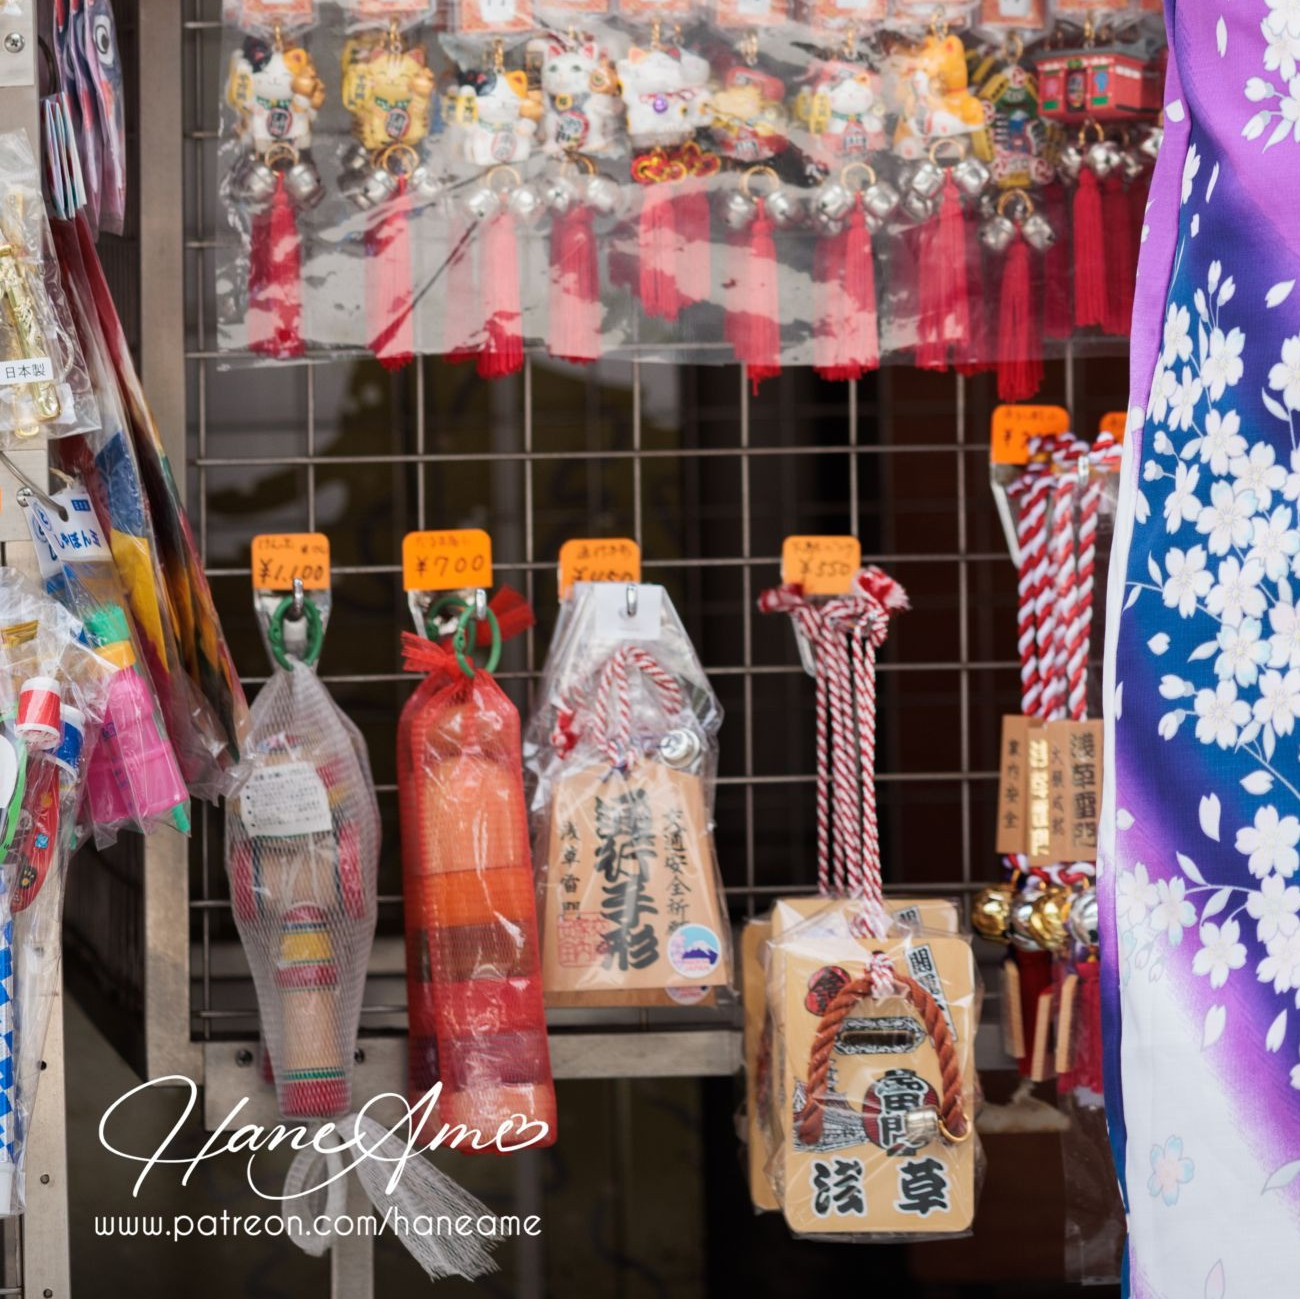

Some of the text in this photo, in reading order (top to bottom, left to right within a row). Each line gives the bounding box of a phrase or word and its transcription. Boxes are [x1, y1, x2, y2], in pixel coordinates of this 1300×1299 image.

[4, 362, 46, 380] 日本製
[415, 554, 486, 578] ¥700
[812, 1158, 949, 1216] 浅草
